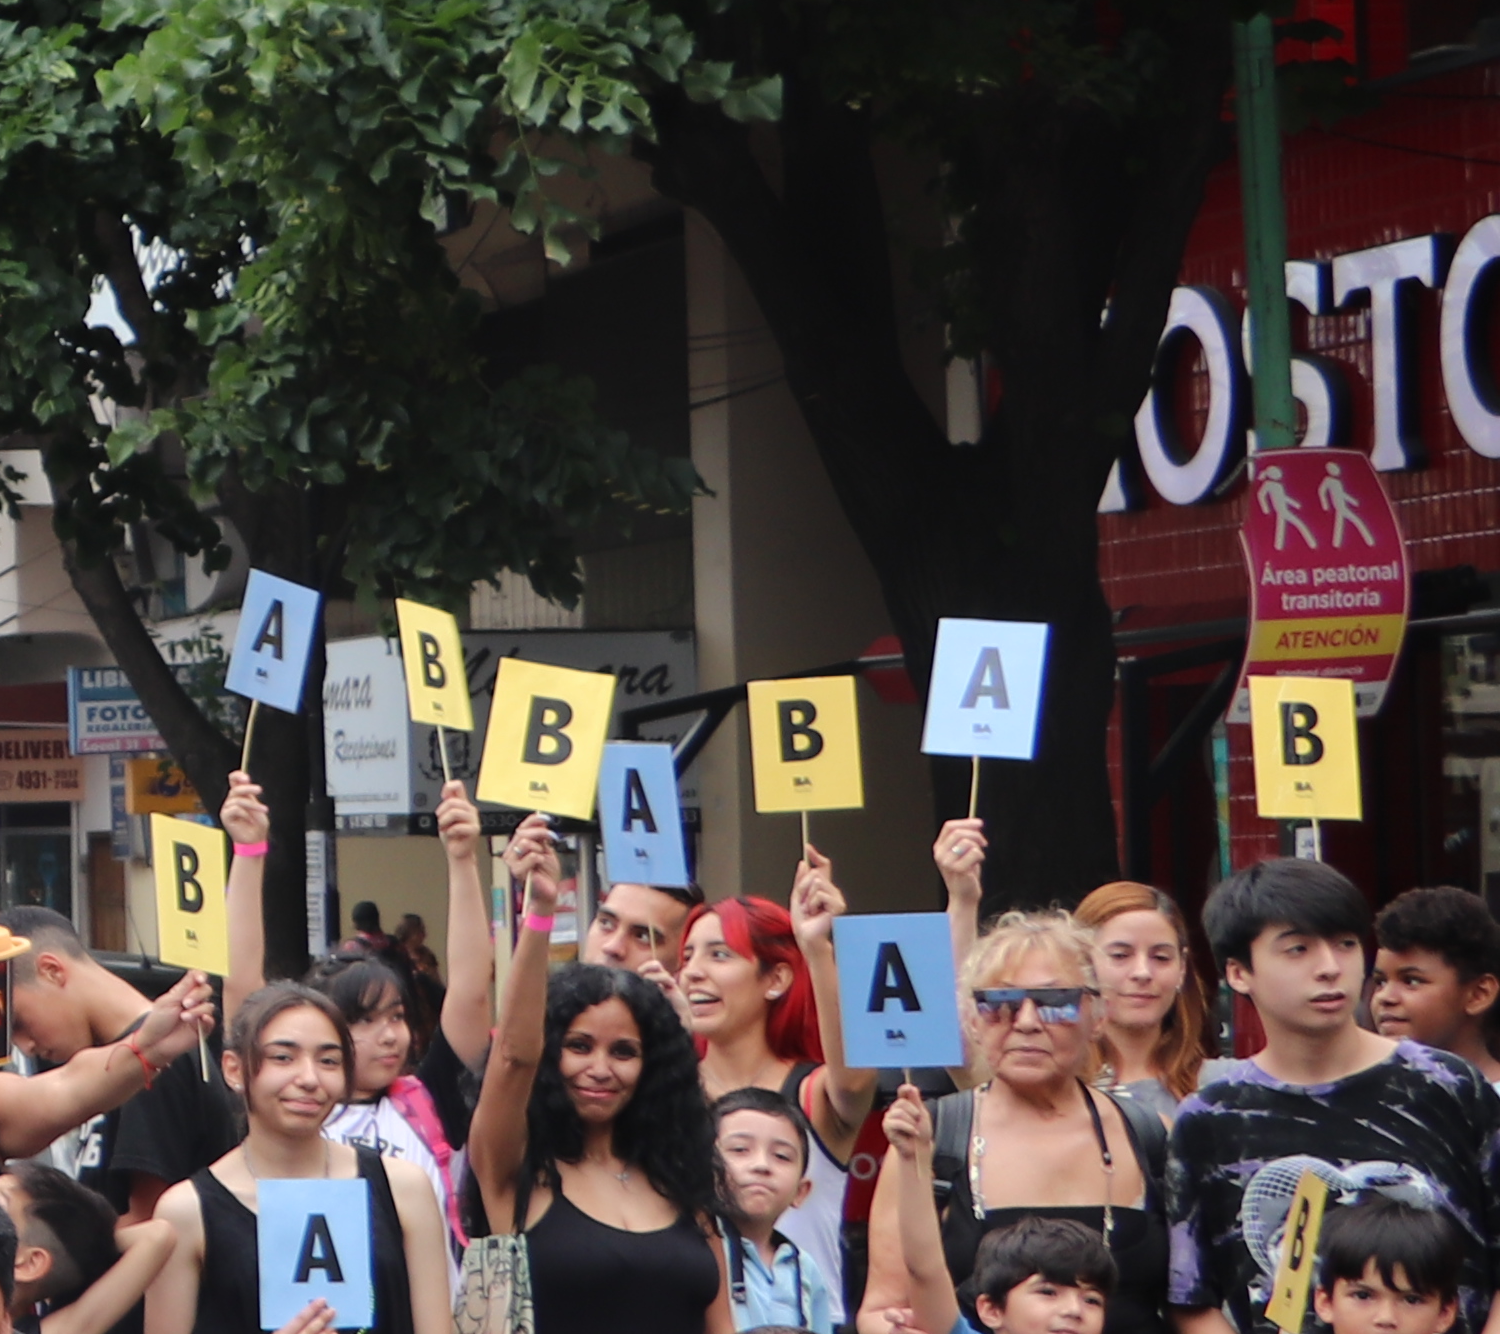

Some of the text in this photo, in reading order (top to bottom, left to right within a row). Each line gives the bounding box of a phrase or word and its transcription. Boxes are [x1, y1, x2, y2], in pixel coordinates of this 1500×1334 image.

[1261, 561, 1399, 586] Área peatonal
[1281, 588, 1381, 611] transitoria
[251, 598, 284, 661] A
[418, 631, 447, 690] B
[1276, 624, 1380, 650] ATENCIÓN
[959, 646, 1011, 710] A
[521, 695, 574, 766] B
[777, 699, 824, 763] B
[1280, 702, 1325, 766] B
[622, 768, 658, 834] A
[174, 842, 204, 914] B
[867, 941, 922, 1013] A
[293, 1213, 345, 1284] A
[1289, 1196, 1310, 1272] B
